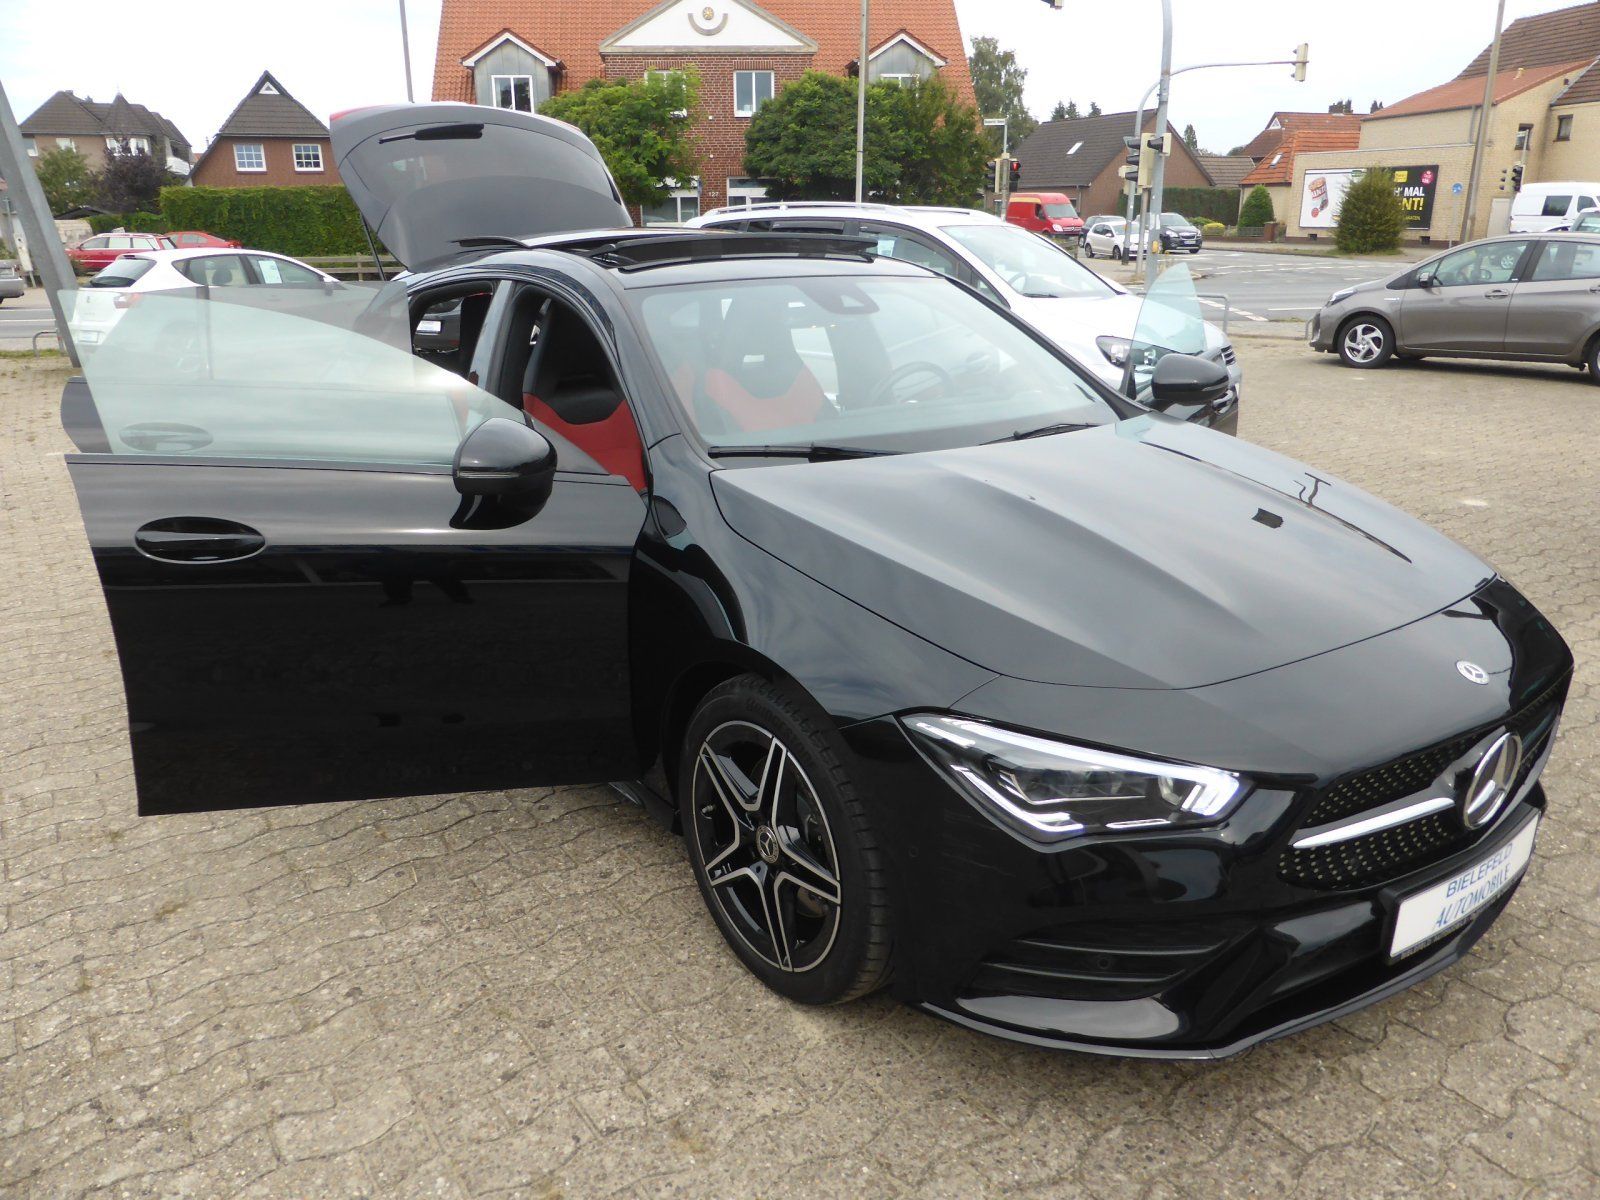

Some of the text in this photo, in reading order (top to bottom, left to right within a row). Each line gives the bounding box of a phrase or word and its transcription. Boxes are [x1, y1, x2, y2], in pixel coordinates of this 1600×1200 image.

[1400, 197, 1424, 211] NT!
[1403, 186, 1425, 197] MAL
[1446, 843, 1513, 898] BIELEFELD
[1435, 863, 1511, 928] AUTOMOBILE
